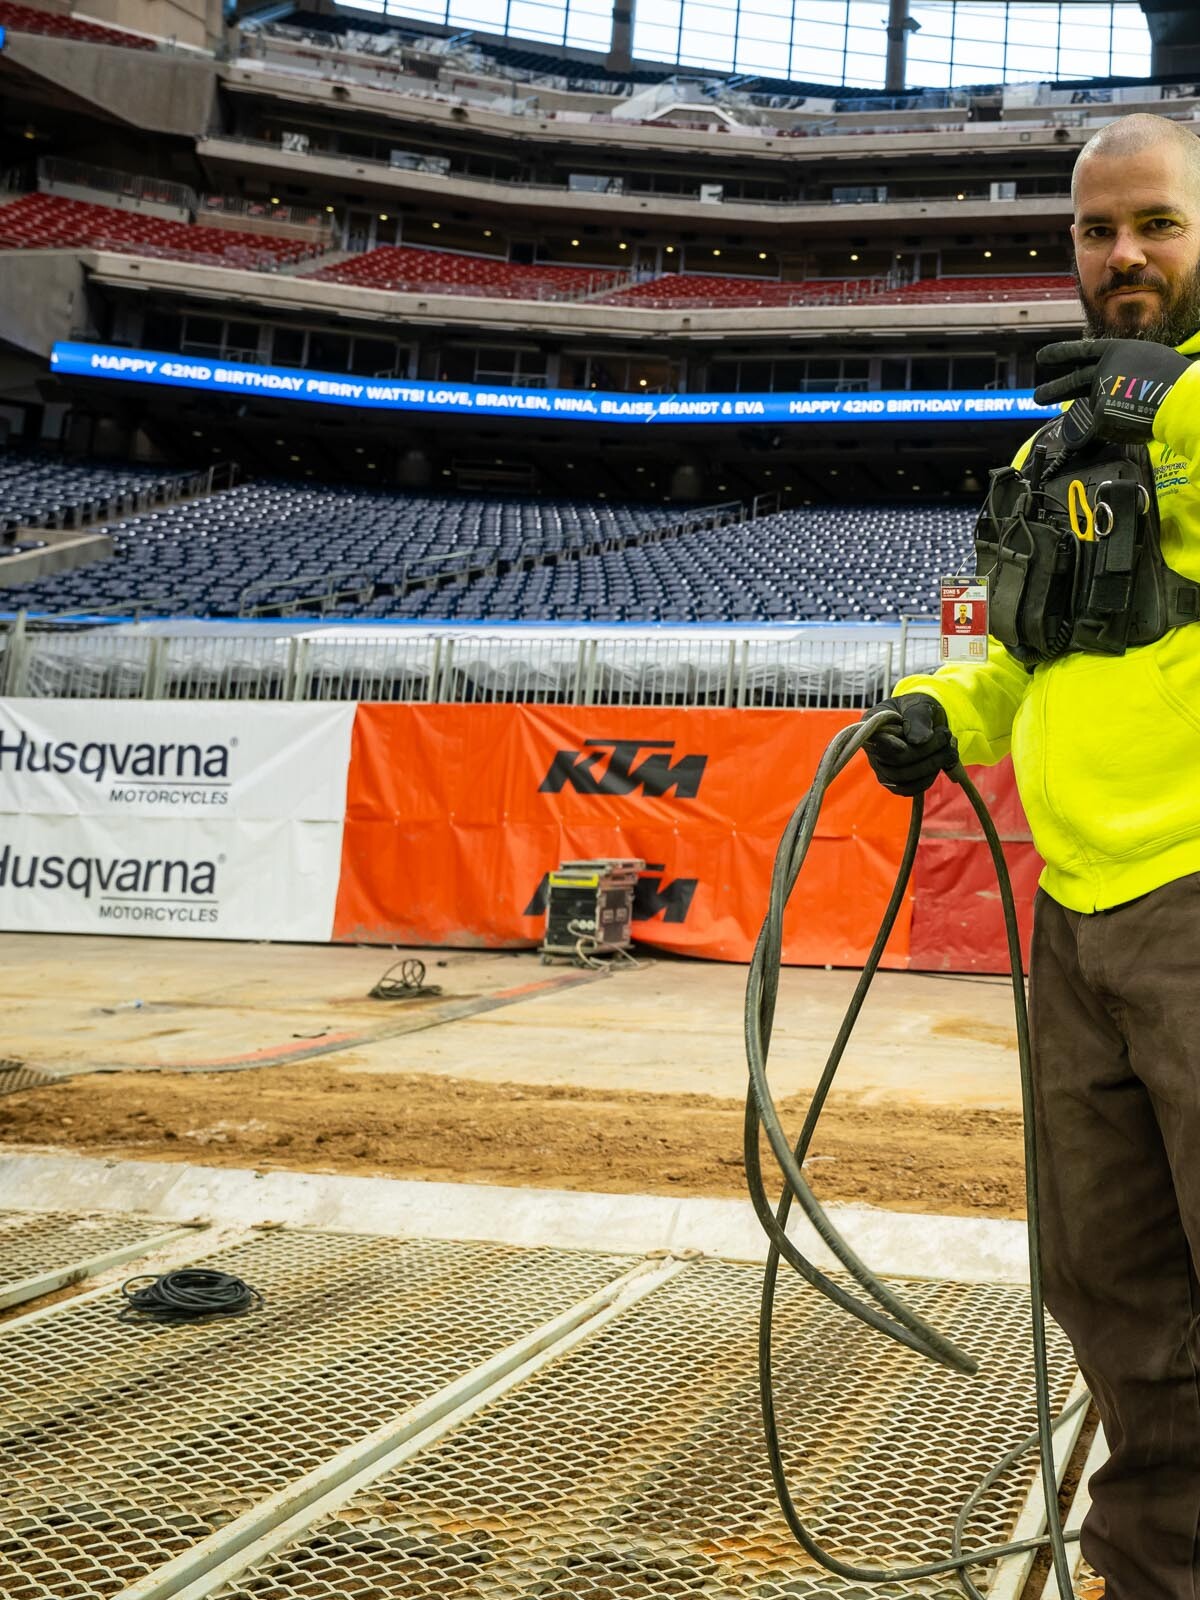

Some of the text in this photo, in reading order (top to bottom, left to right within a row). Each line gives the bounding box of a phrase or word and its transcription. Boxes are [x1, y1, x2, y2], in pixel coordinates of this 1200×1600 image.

[91, 355, 157, 373] HAPPY
[160, 363, 211, 380] 42ND
[214, 369, 304, 390] BIRTHDAY
[307, 380, 363, 398] PERRY
[427, 391, 473, 406] LOVE,
[476, 393, 552, 410] BRAYLEN,
[554, 398, 598, 413] NINA,
[660, 402, 720, 414] BRANDT
[721, 402, 732, 414] &
[734, 402, 764, 414] EVA
[789, 401, 841, 413] HAPPY
[843, 400, 884, 413] 42ND
[886, 399, 963, 412] BIRTHDAY
[964, 399, 1016, 411] PERRY
[538, 739, 708, 798] KTM
[109, 789, 228, 805] MOTORCYCLES
[99, 905, 219, 922] MOTORCYCLES
